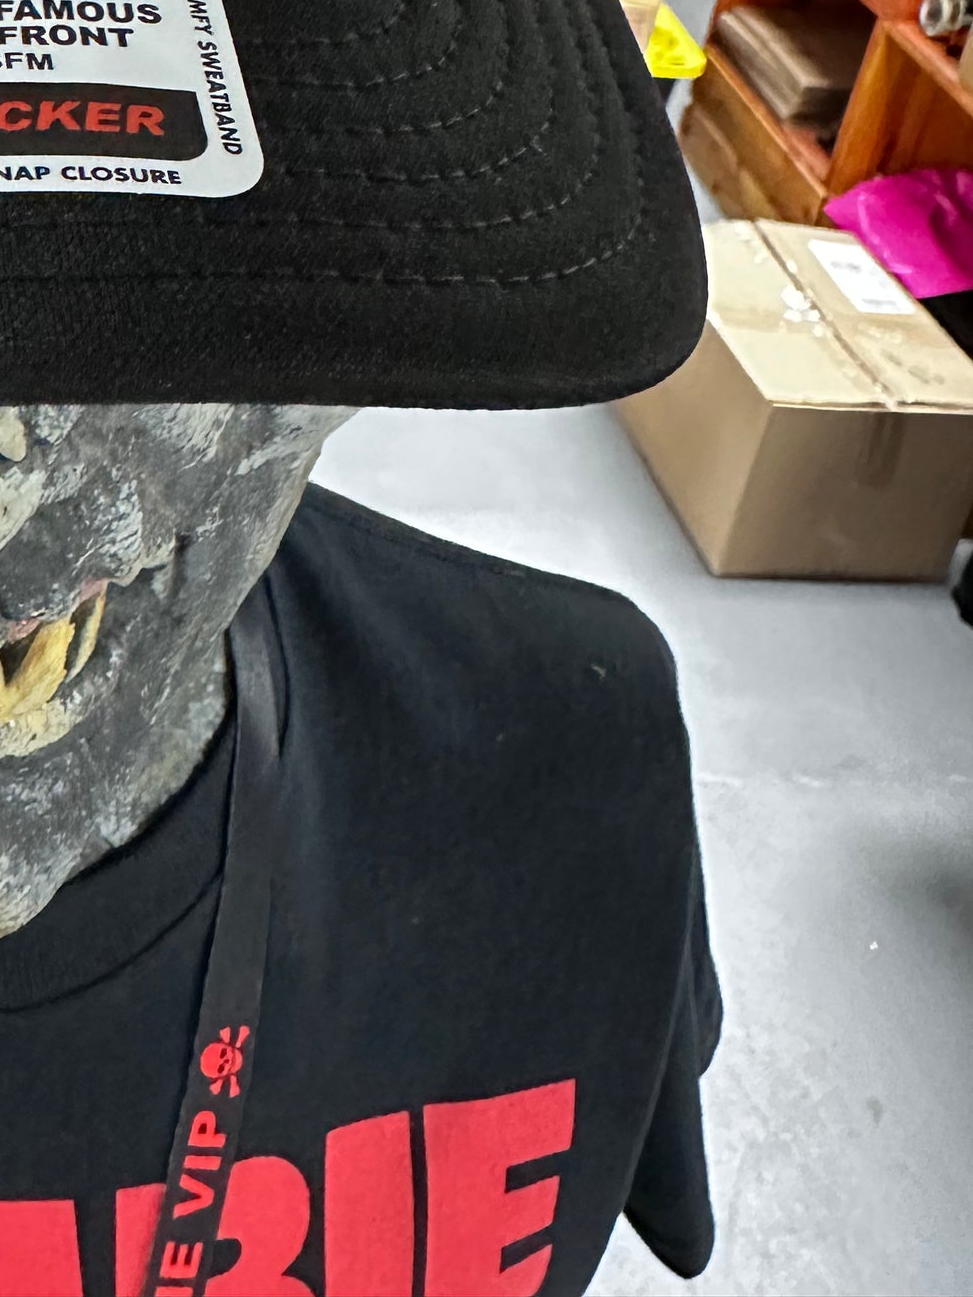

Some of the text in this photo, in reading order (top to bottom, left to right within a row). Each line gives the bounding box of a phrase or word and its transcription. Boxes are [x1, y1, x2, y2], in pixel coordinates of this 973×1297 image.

[197, 40, 243, 155] SWEATBAND
[60, 165, 183, 186] CLOSURE
[172, 1109, 228, 1221] VIP
